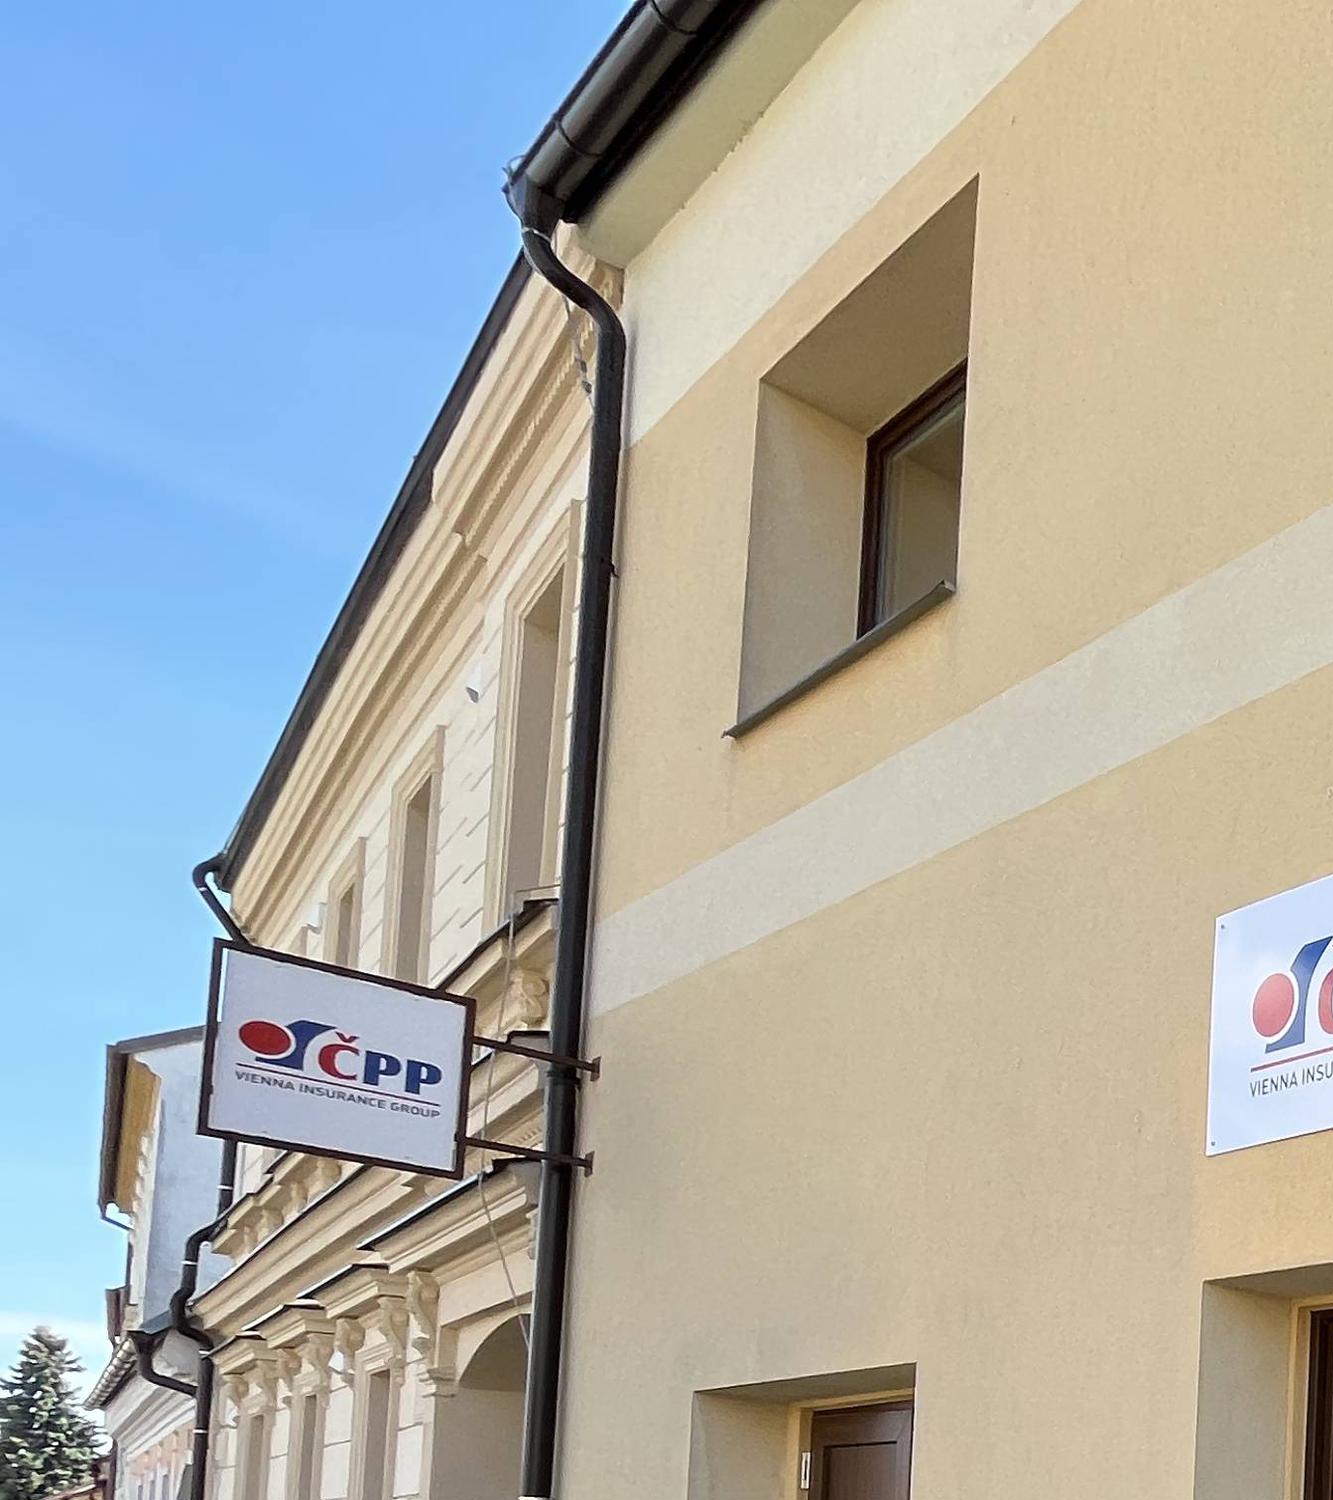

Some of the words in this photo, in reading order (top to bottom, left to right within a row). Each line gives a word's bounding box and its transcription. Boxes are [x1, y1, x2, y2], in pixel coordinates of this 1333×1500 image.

[317, 1032, 443, 1095] ČPP
[1250, 1072, 1298, 1097] VIENNA
[235, 1070, 295, 1091] VIENNA
[299, 1084, 387, 1109] INSURANCE
[390, 1101, 441, 1119] GROUP
